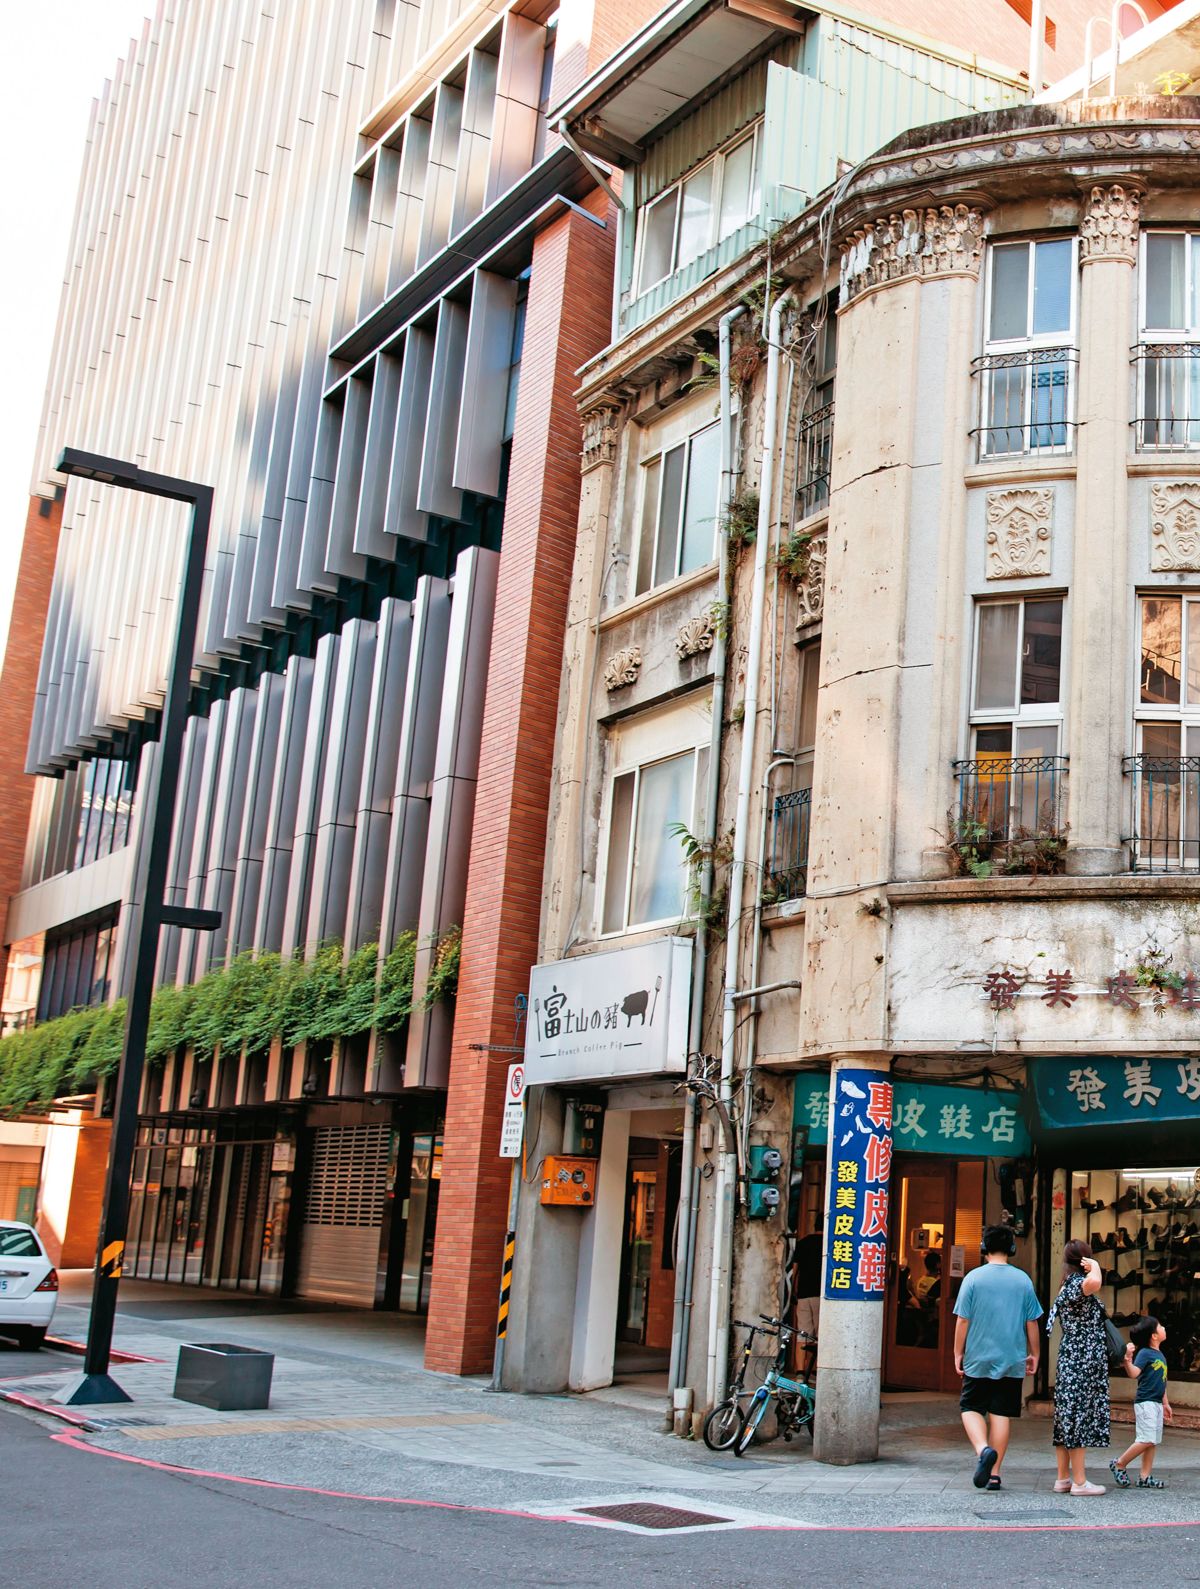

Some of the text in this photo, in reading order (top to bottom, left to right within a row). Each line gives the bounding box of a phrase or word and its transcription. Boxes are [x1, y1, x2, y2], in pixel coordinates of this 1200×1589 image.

[804, 1090, 1017, 1143] 發皮鞋店
[831, 1160, 859, 1289] 發美皮鞋店
[857, 1081, 893, 1292] 專修皮鞋
